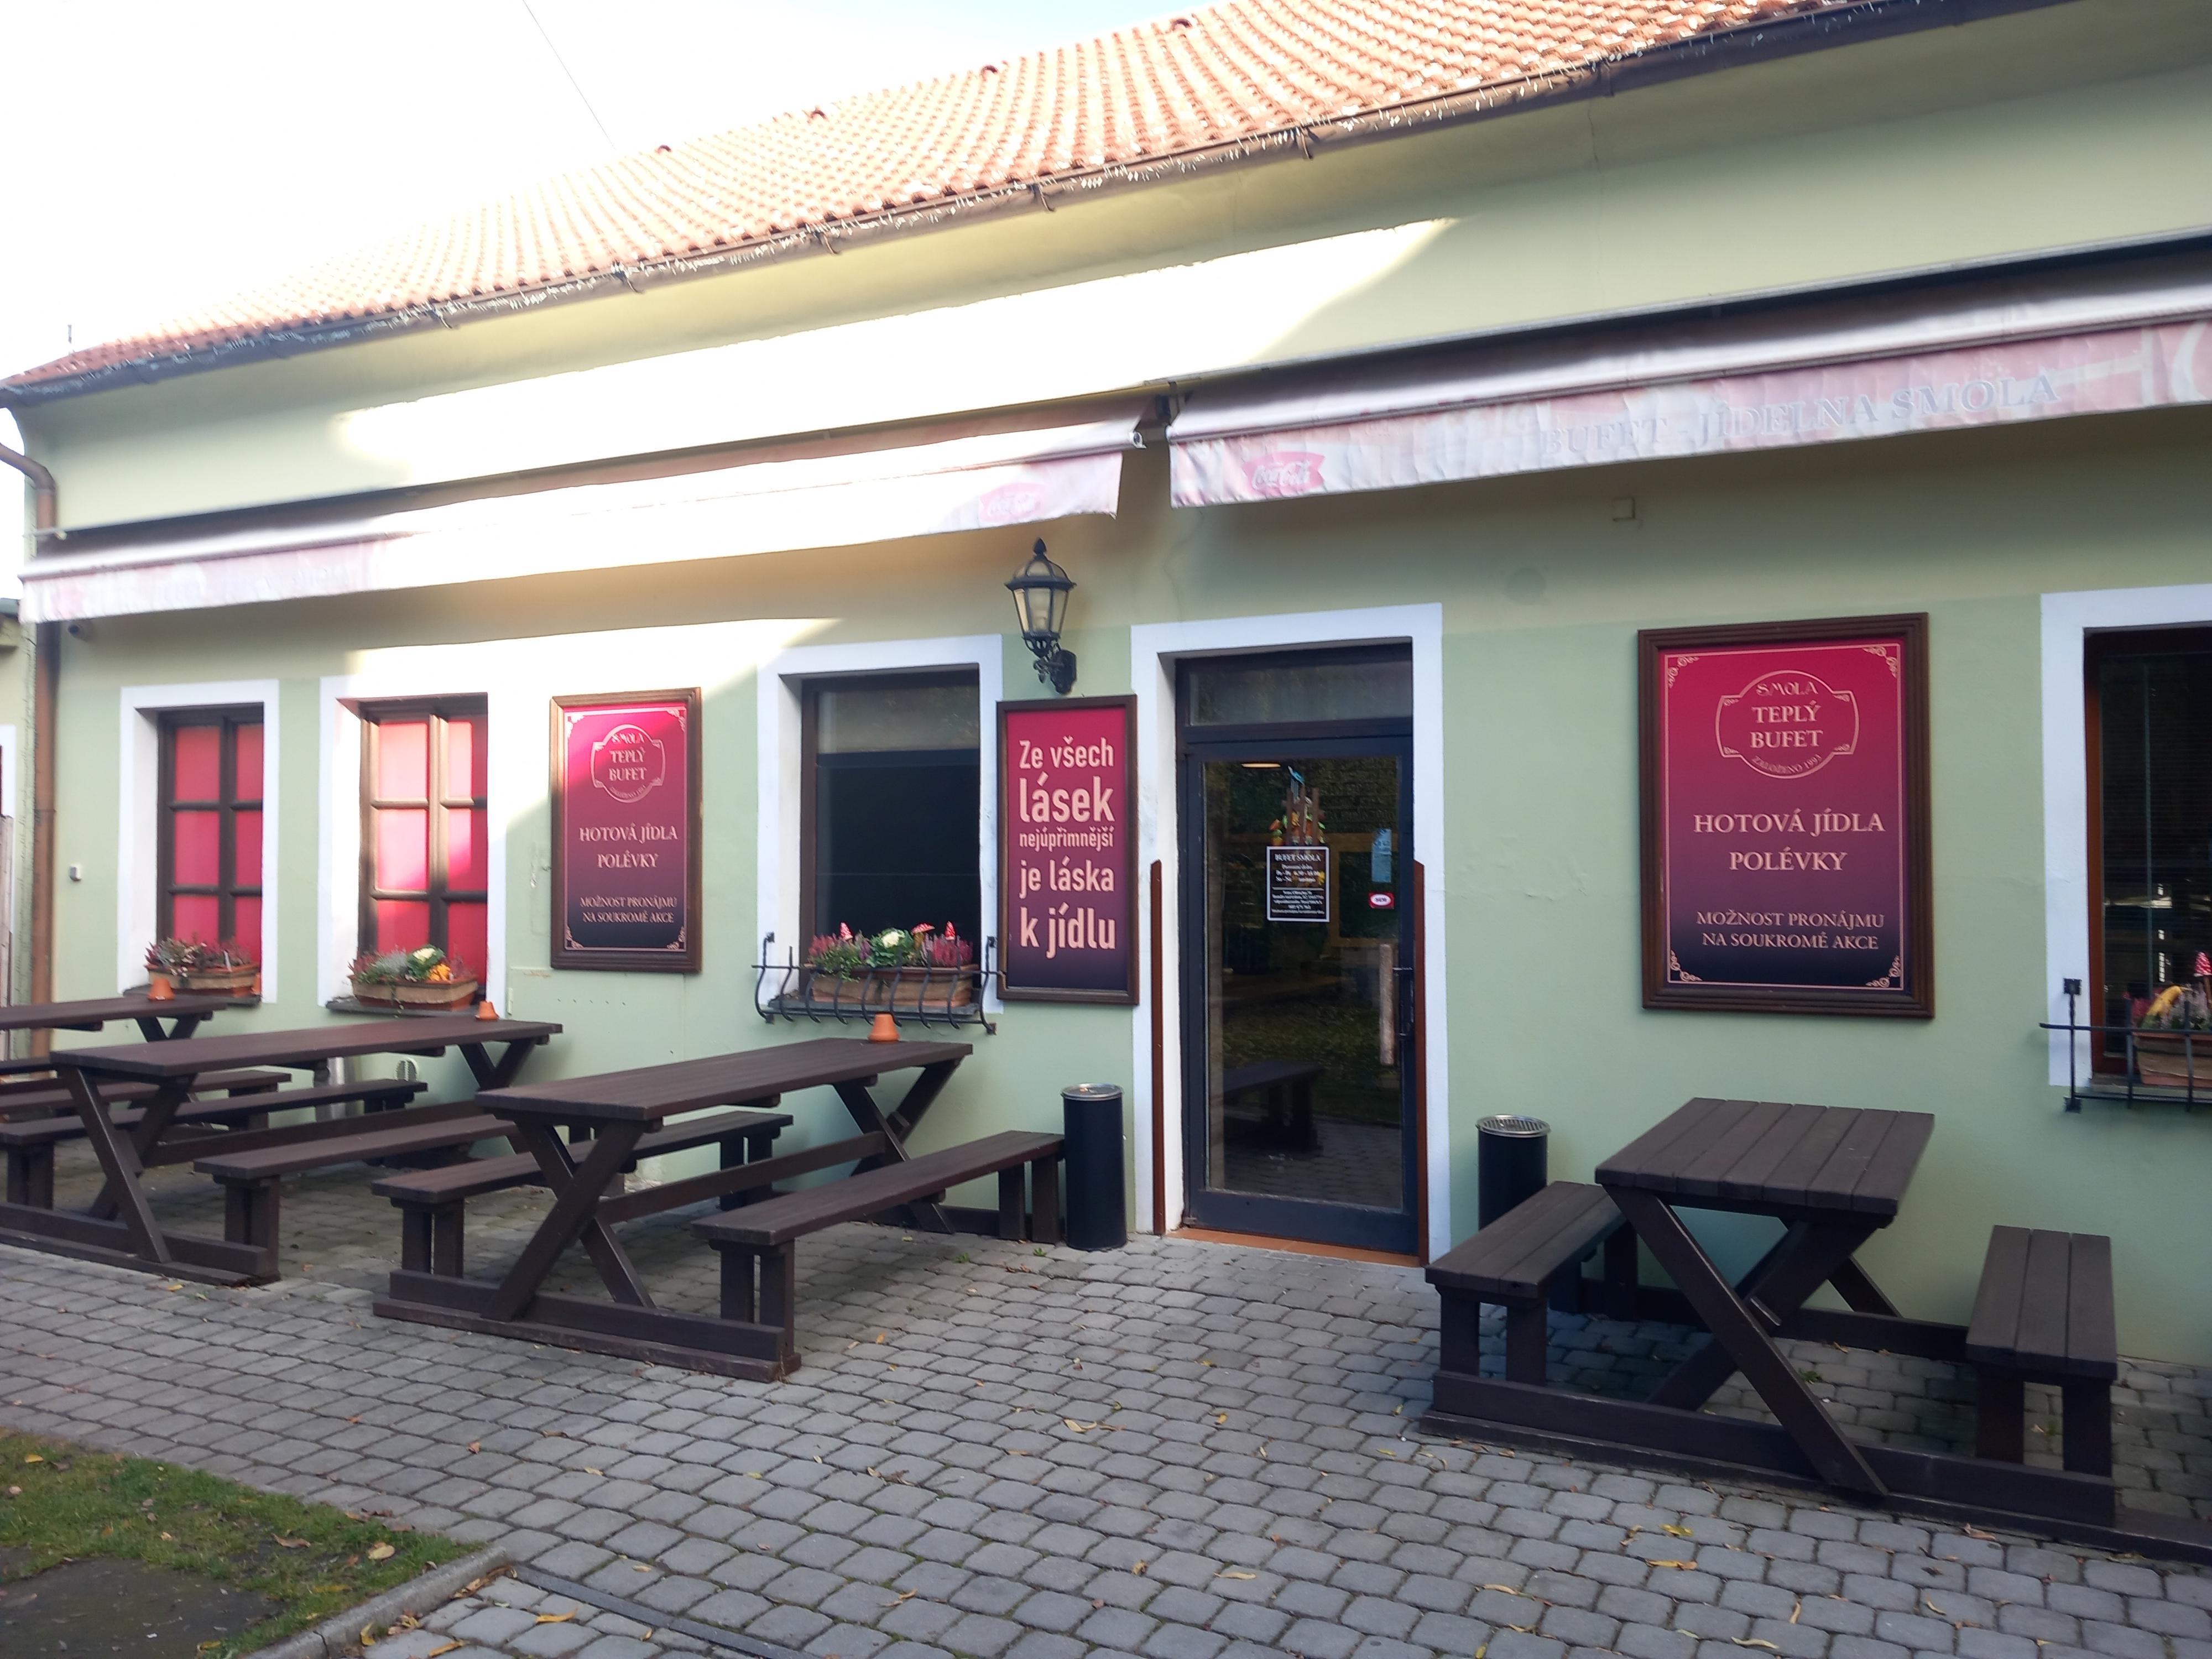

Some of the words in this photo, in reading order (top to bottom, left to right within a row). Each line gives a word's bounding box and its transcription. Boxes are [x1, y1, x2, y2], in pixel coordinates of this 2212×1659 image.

[1891, 368, 2061, 419] SMOLA
[1755, 680, 1819, 697] SMOLA
[1750, 700, 1822, 723] TEPLÝ
[1749, 729, 1824, 749] BUFET
[609, 747, 646, 764] TEPLÝ
[1018, 739, 1044, 770] Ze
[1050, 734, 1114, 769] všech
[608, 766, 648, 782] BUFET
[1018, 771, 1115, 823] lásek
[579, 822, 638, 842] HOTOVÁ
[638, 822, 679, 844] JÍDLA
[1693, 807, 1806, 833] HOTOVÁ
[1809, 807, 1886, 837] JÍDLA
[597, 849, 660, 868] POLÉVKY
[1729, 846, 1848, 872] POLÉVKY
[1018, 859, 1042, 900] je
[1048, 855, 1115, 892] láska
[580, 894, 627, 908] MOŽNOST
[627, 894, 677, 910] PRONÁJMU
[582, 912, 597, 924] NA
[597, 910, 650, 924] SOUKROMÉ
[649, 911, 675, 924] AKCE
[1696, 908, 1784, 927] MOŽNOST
[1787, 909, 1885, 931] PRONÁJMU
[1019, 905, 1040, 948] k
[1046, 901, 1116, 959] jídlu
[1702, 932, 1728, 948] NA
[1730, 931, 1829, 949] SOUKROMÉ
[1832, 935, 1879, 950] AKCE
